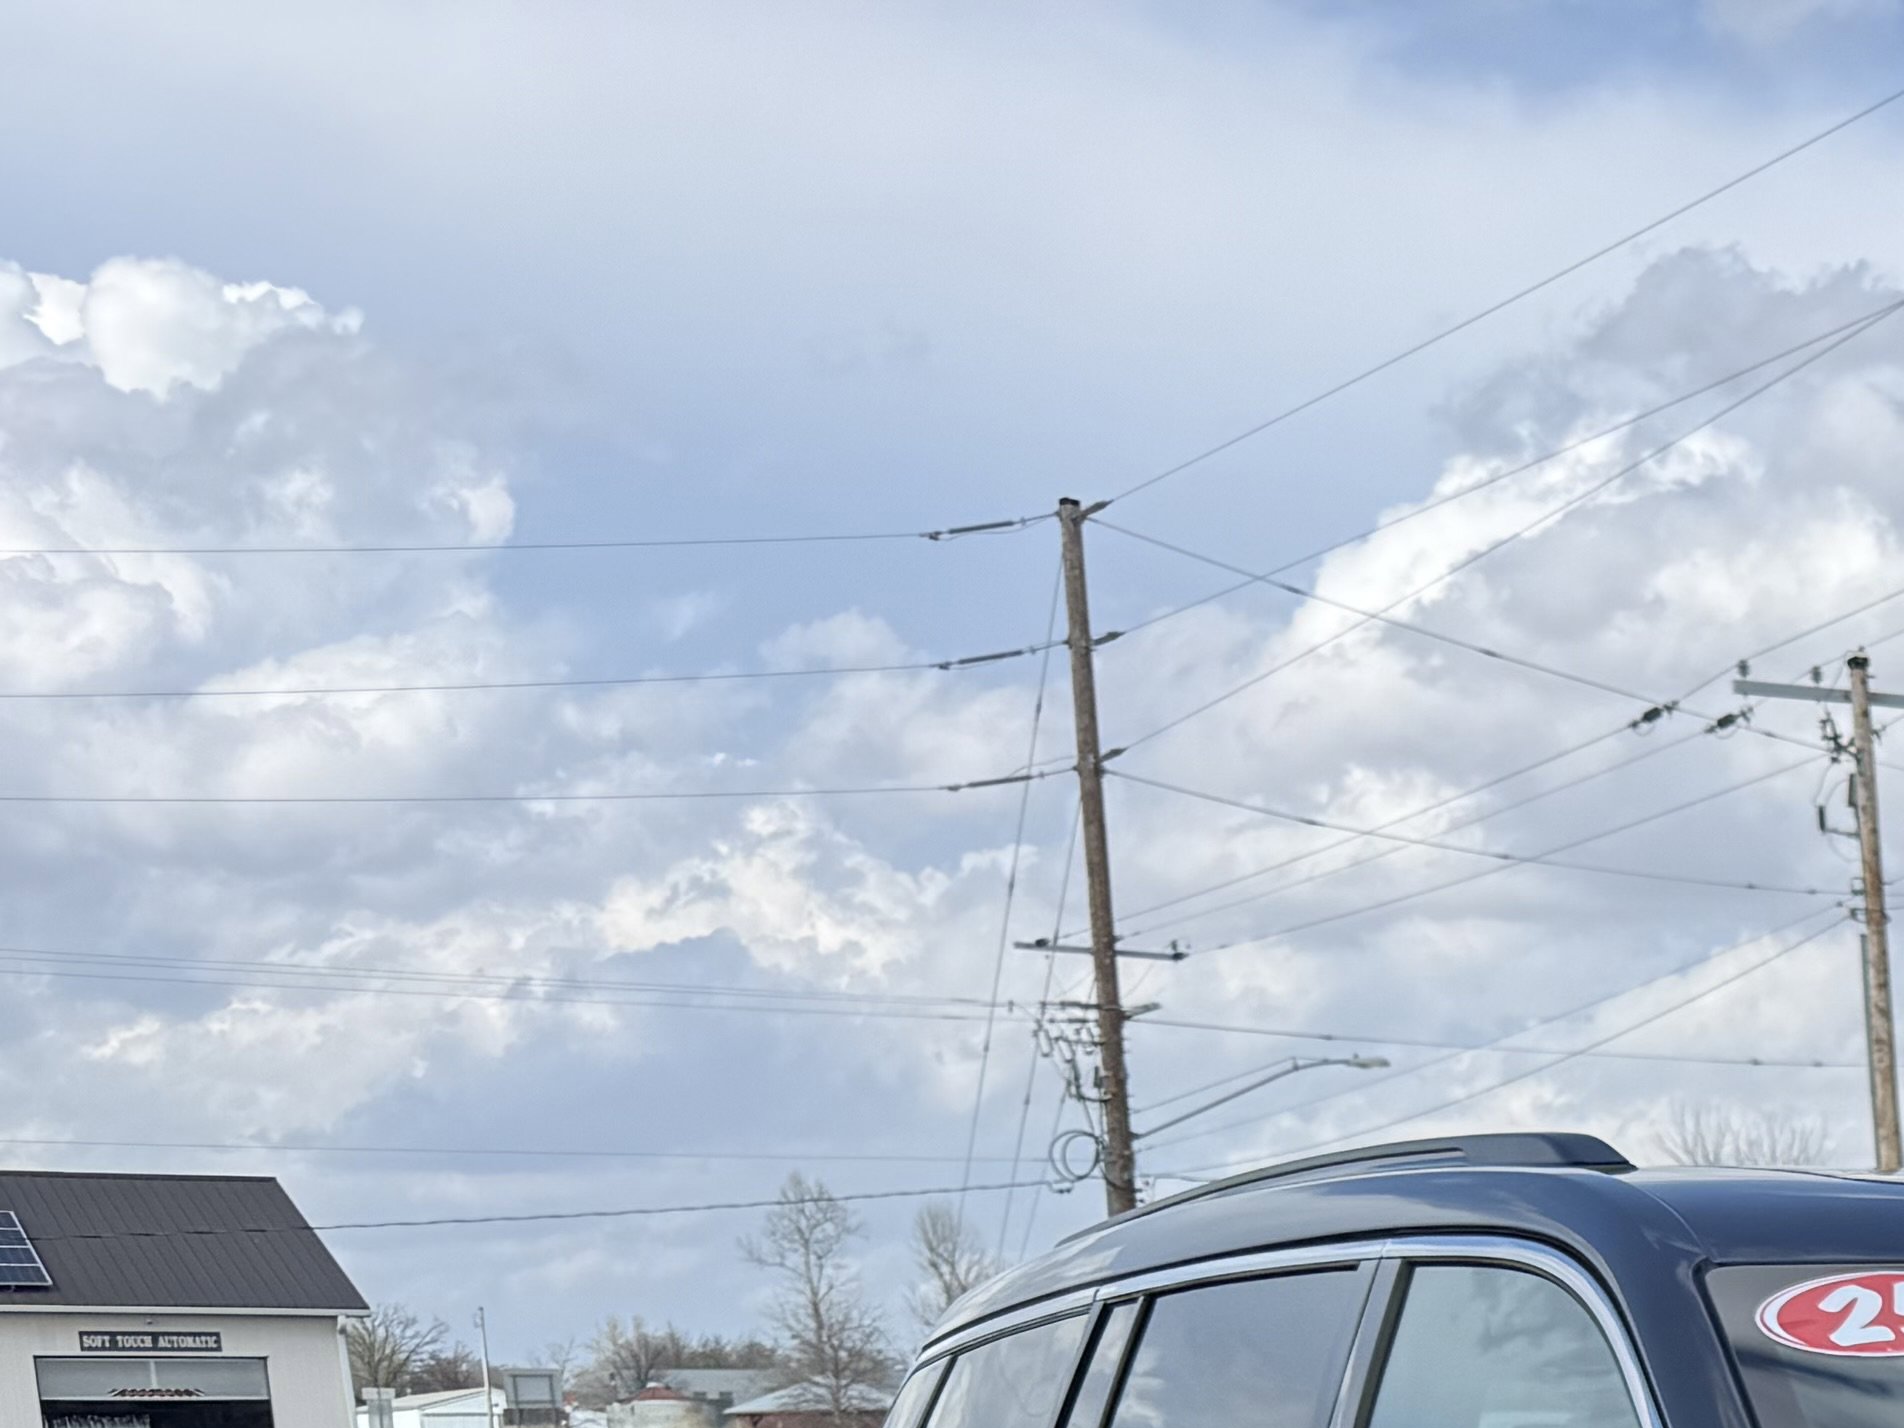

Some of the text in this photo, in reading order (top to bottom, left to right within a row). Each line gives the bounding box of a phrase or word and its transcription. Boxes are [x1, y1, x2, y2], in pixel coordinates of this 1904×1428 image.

[82, 1335, 218, 1349] SOFT TOUCH AUTOMATIC
